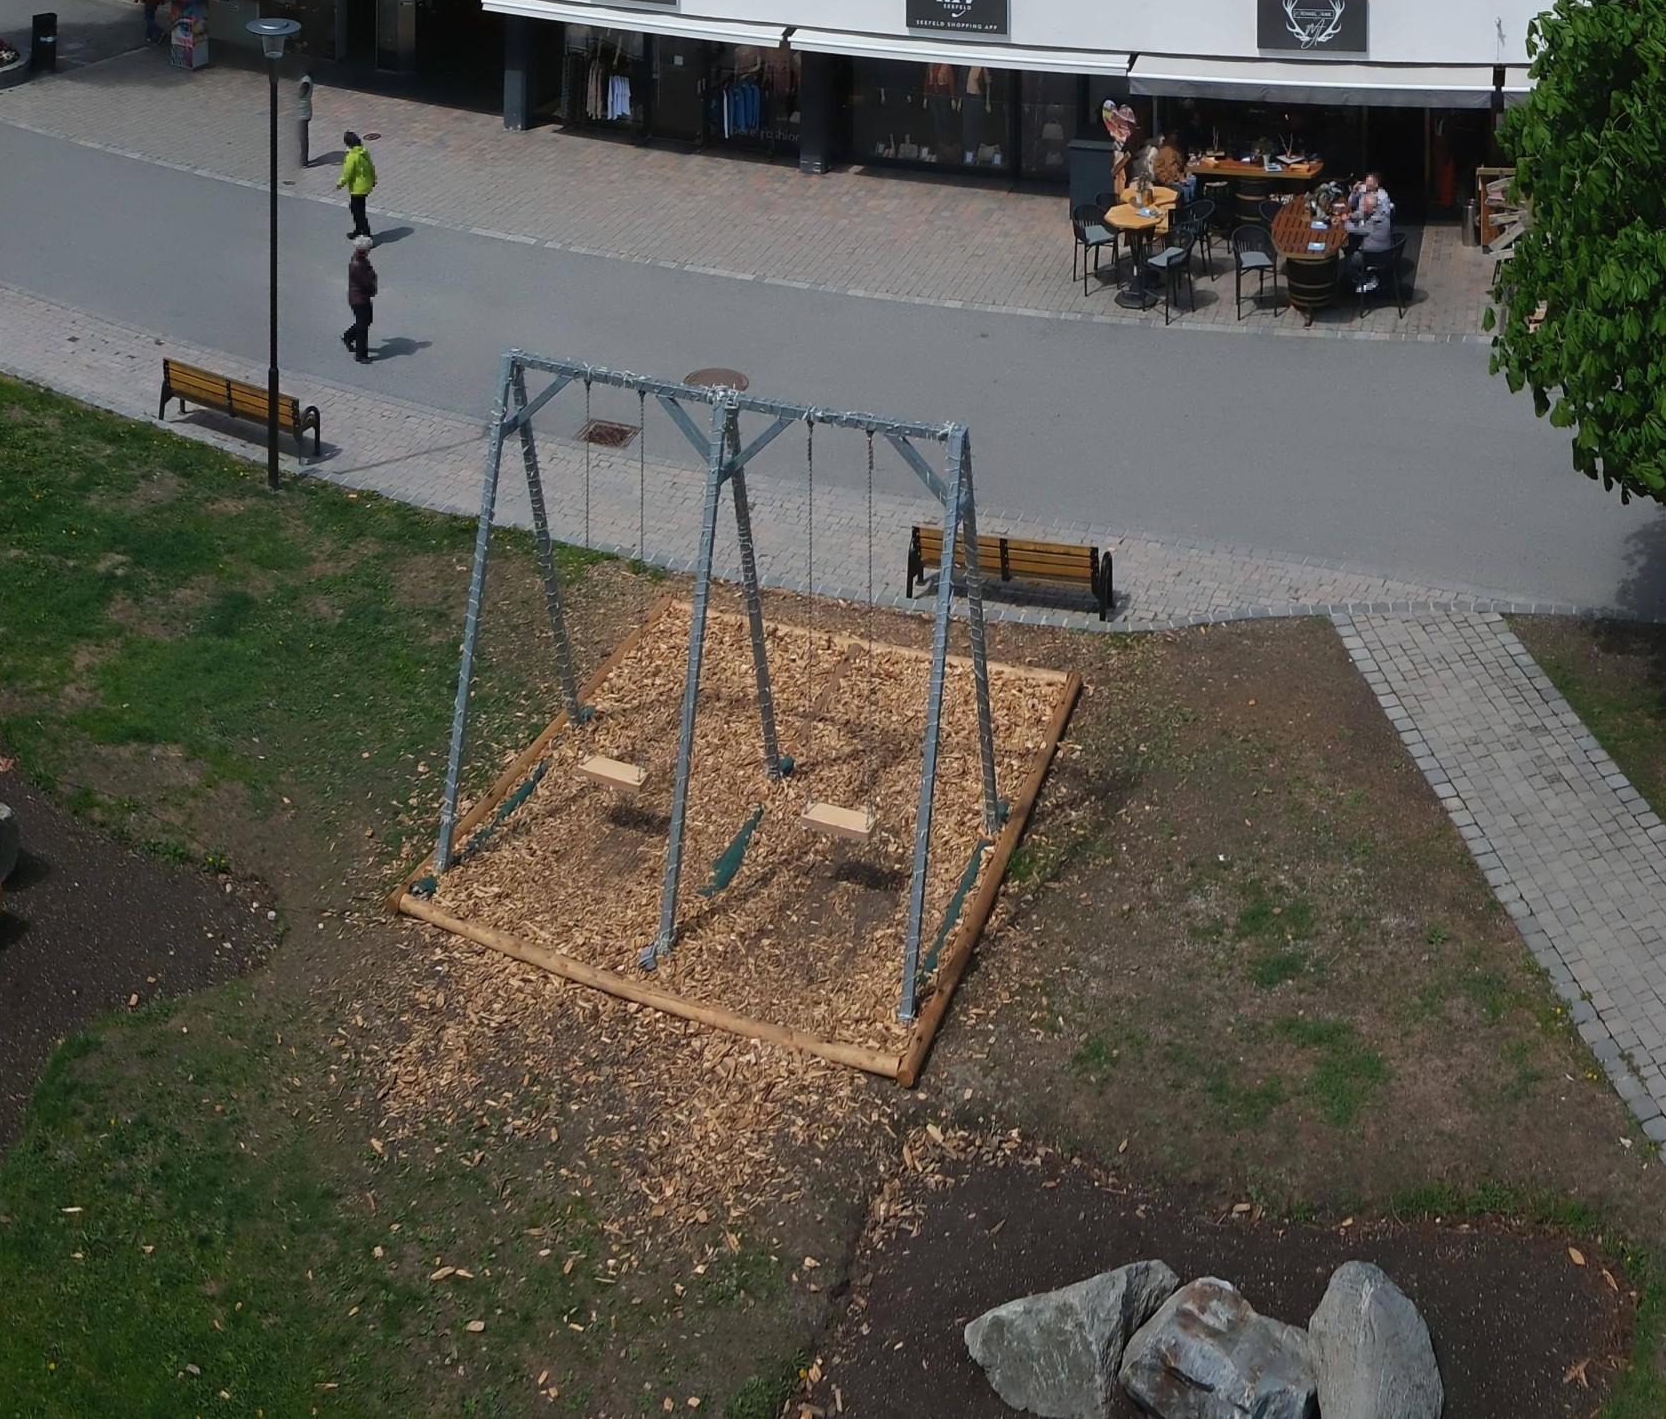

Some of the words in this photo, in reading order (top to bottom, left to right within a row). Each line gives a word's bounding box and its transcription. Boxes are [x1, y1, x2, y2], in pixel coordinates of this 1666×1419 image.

[942, 3, 972, 11] SEEFELD
[915, 19, 946, 28] SEEFELD
[946, 21, 982, 29] SHOPPING
